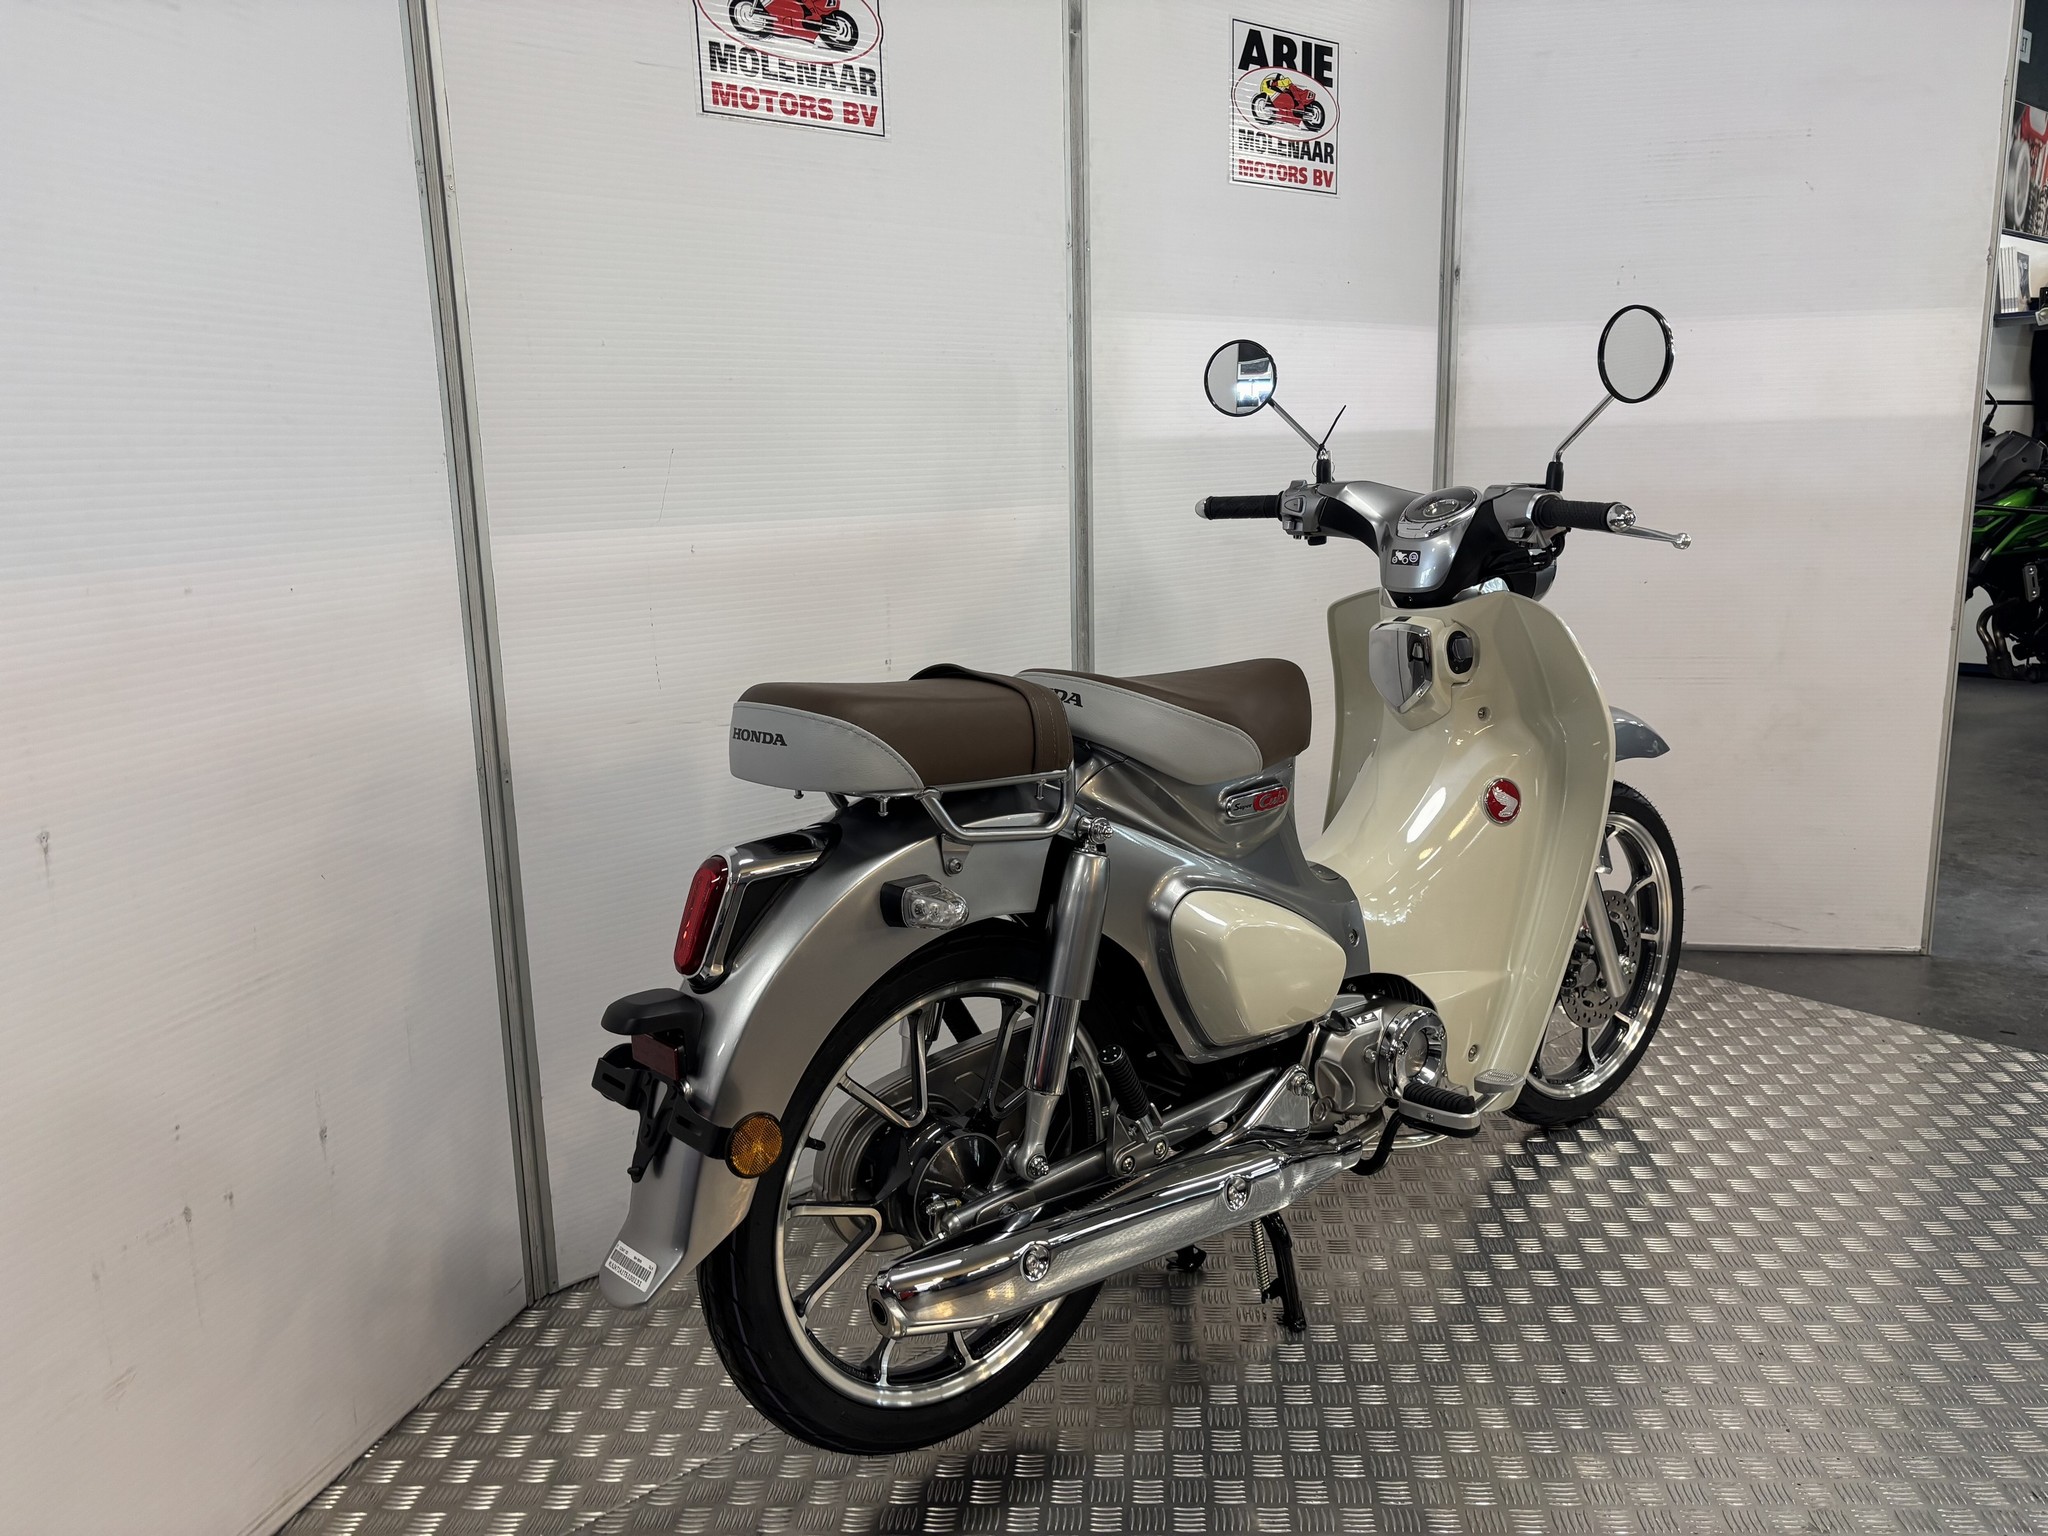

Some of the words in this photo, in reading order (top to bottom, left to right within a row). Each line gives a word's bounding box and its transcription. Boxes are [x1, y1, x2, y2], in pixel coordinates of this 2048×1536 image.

[708, 41, 877, 97] MOLENAAR
[1238, 29, 1333, 88] ARIE
[711, 81, 834, 121] MOTORS
[843, 101, 878, 128] BV
[1238, 129, 1334, 164] MOLENAAR
[1238, 159, 1308, 184] MOTORS
[1313, 169, 1334, 188] BV
[732, 727, 788, 747] HONDA
